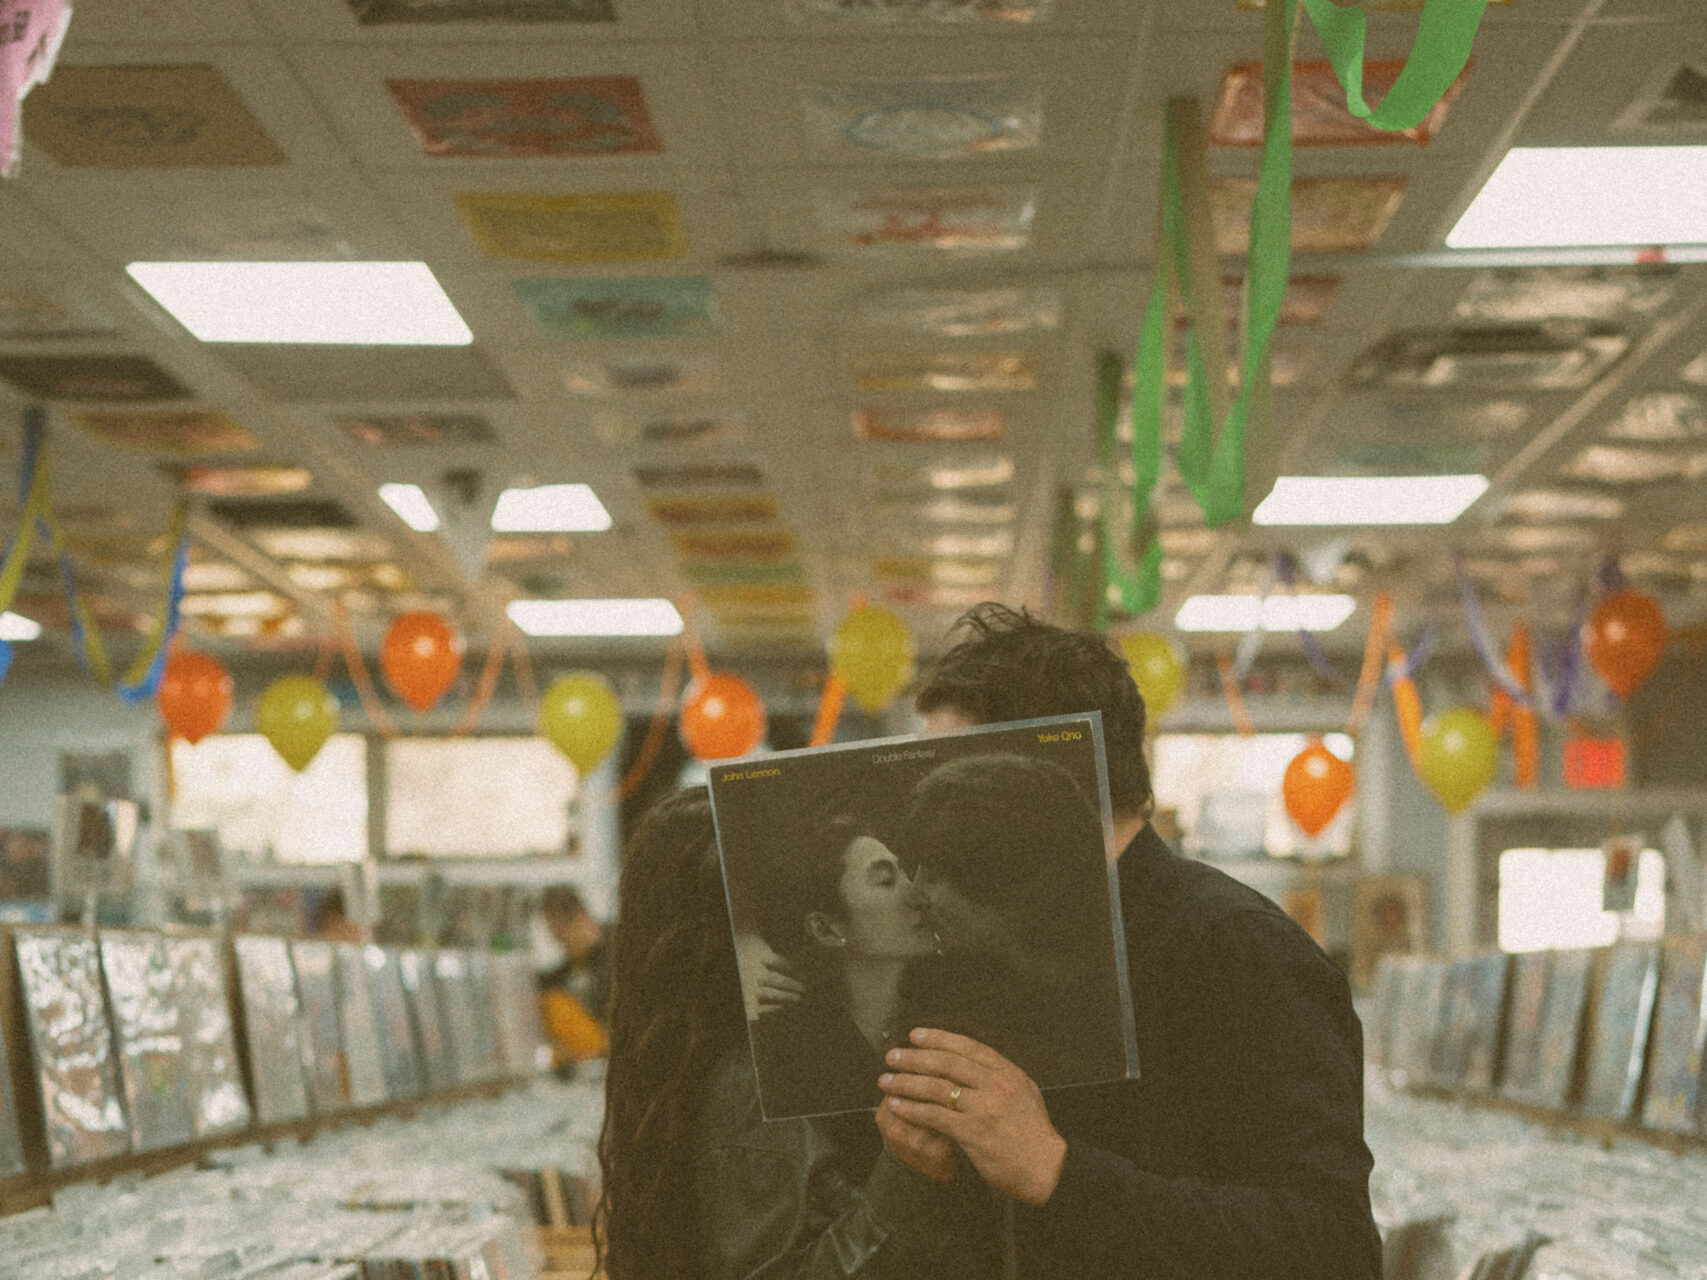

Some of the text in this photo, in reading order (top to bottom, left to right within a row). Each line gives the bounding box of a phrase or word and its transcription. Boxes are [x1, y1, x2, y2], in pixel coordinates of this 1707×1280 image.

[1038, 731, 1082, 743] Yoko Ono
[721, 768, 781, 782] John Lennon
